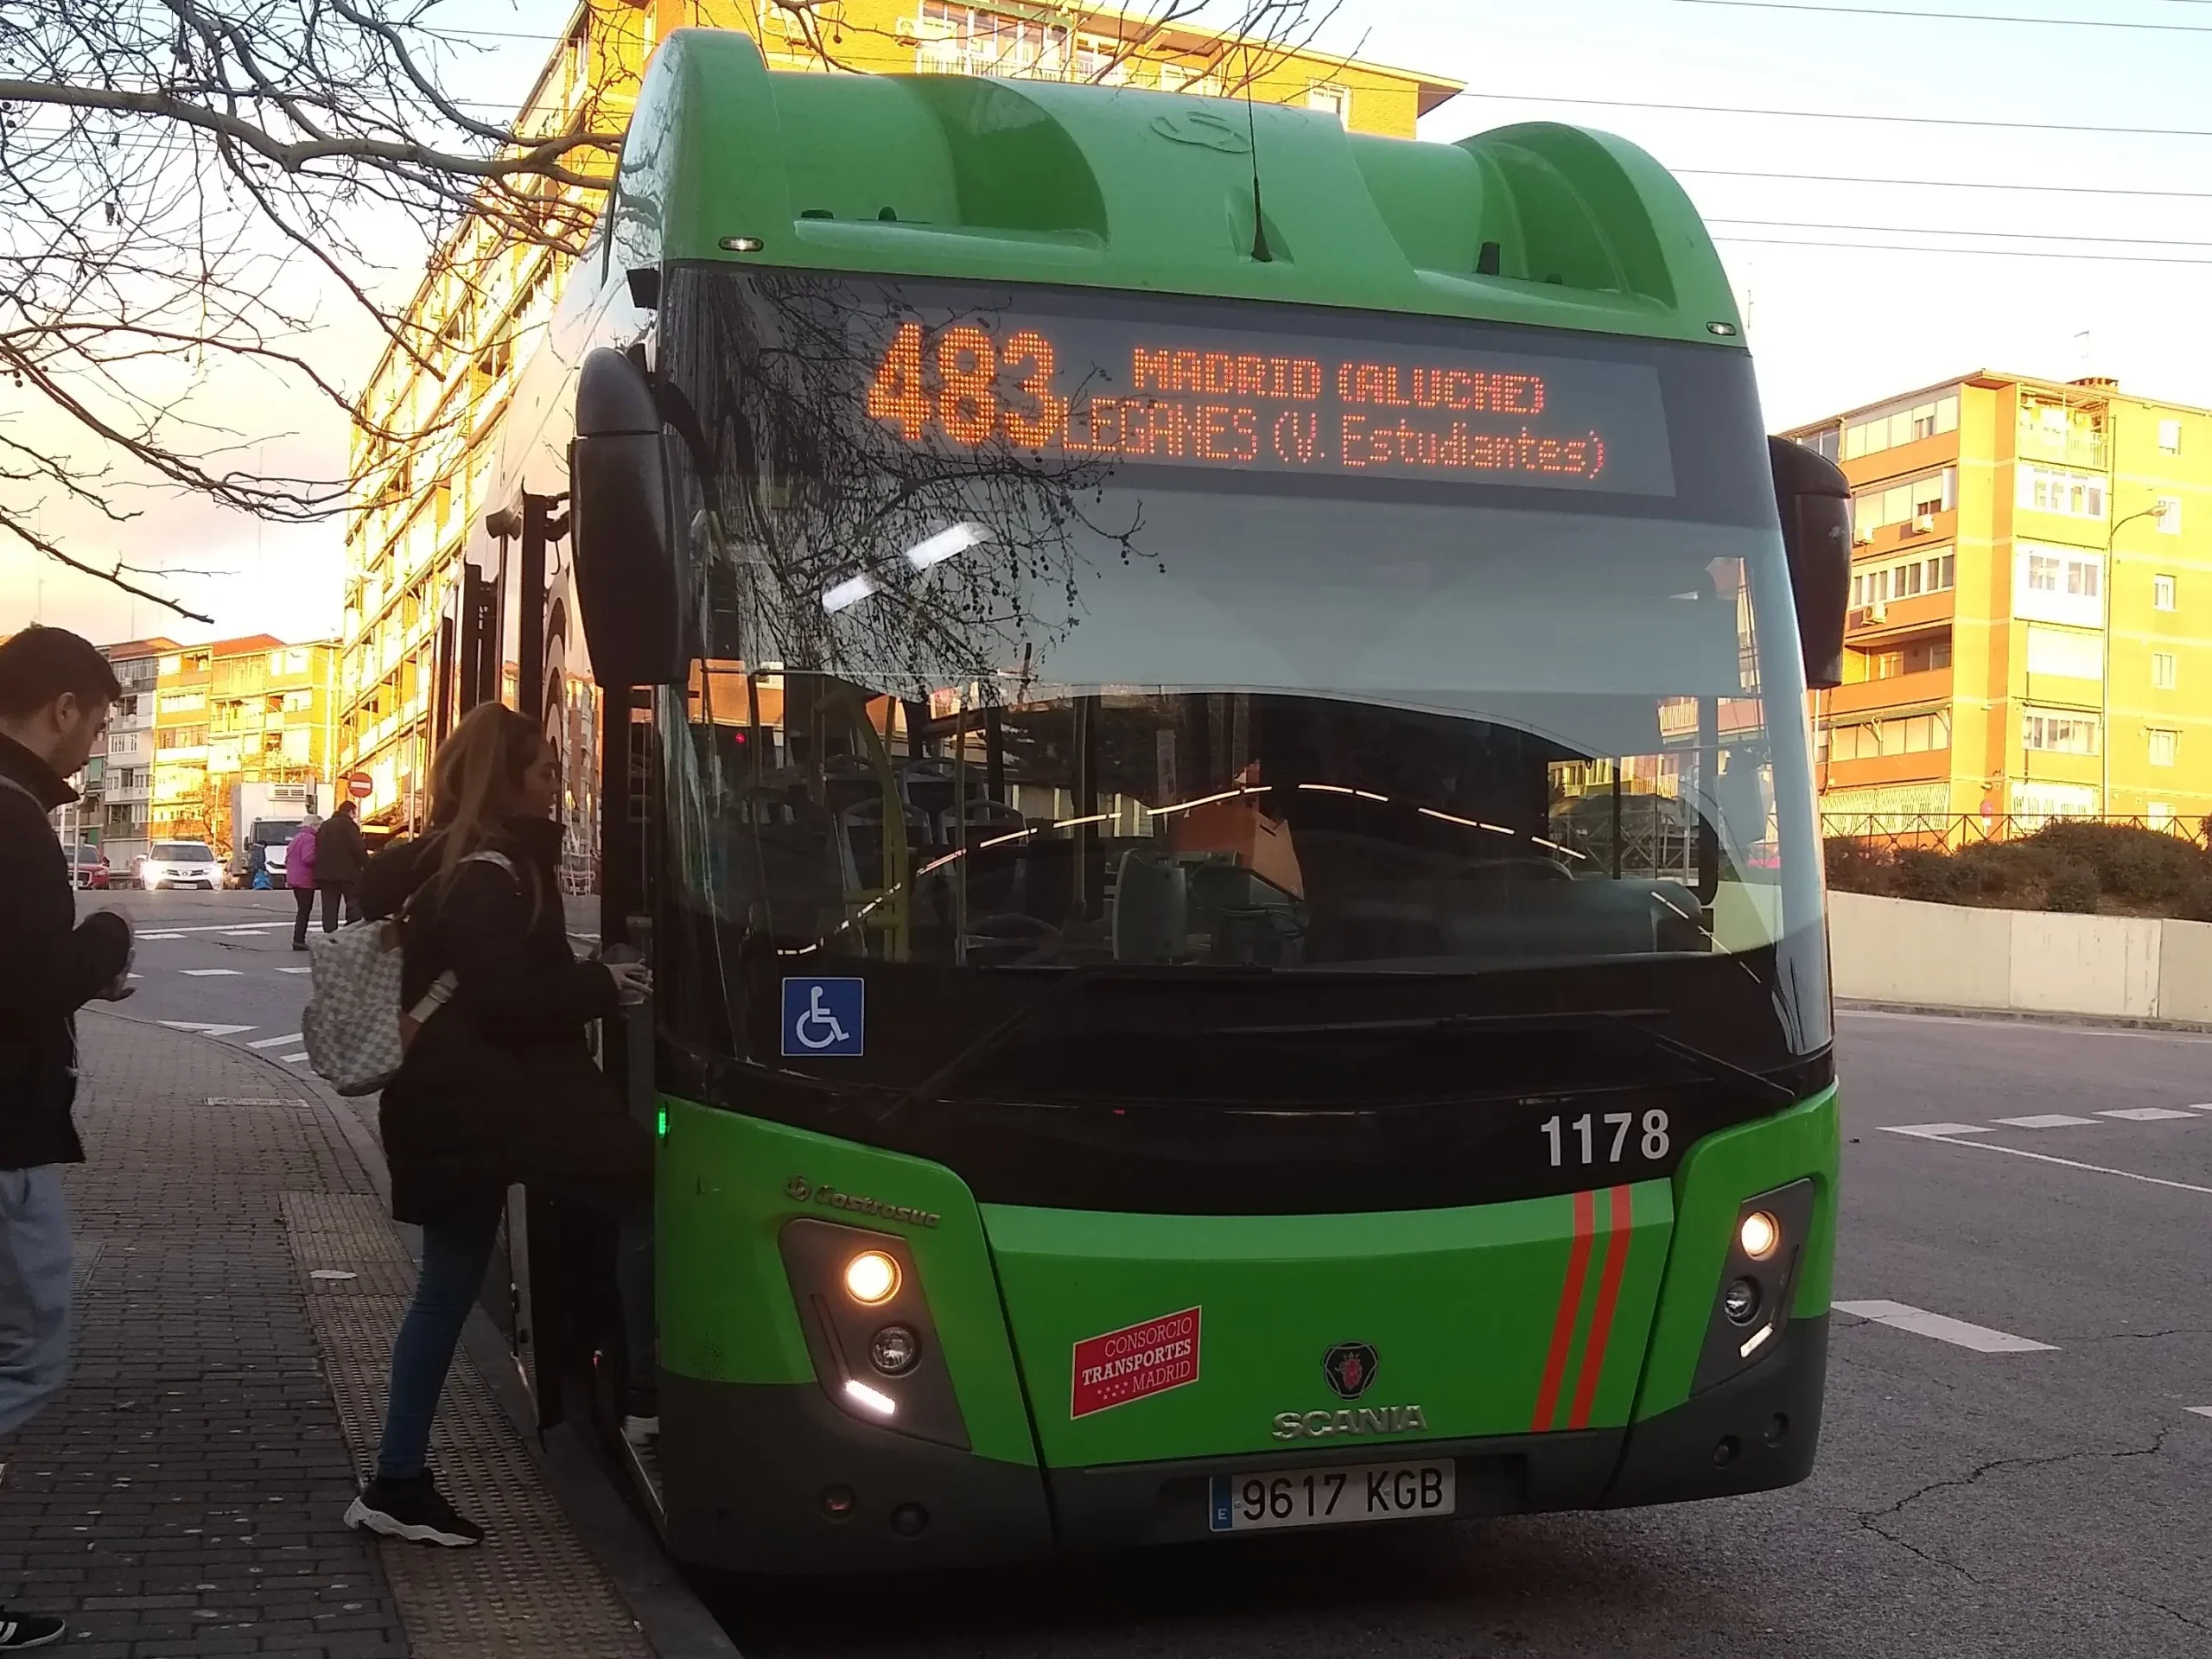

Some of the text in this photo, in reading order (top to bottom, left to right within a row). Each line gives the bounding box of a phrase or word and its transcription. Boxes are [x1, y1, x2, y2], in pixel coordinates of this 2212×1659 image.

[868, 321, 1060, 449] 483
[1133, 346, 1545, 415] MADRID (ALUCHE)
[1063, 395, 1606, 480] LEGANES (V. Estudiantes)
[1541, 1109, 1670, 1166] 1178
[815, 1185, 941, 1227] Castrosua
[1081, 1338, 1192, 1387] TRANSPORTES
[1104, 1316, 1193, 1358] CONSORCIO
[1131, 1359, 1192, 1394] MADRID
[1270, 1404, 1428, 1442] SCANIA
[1217, 1466, 1445, 1522] E 9617 KGB
